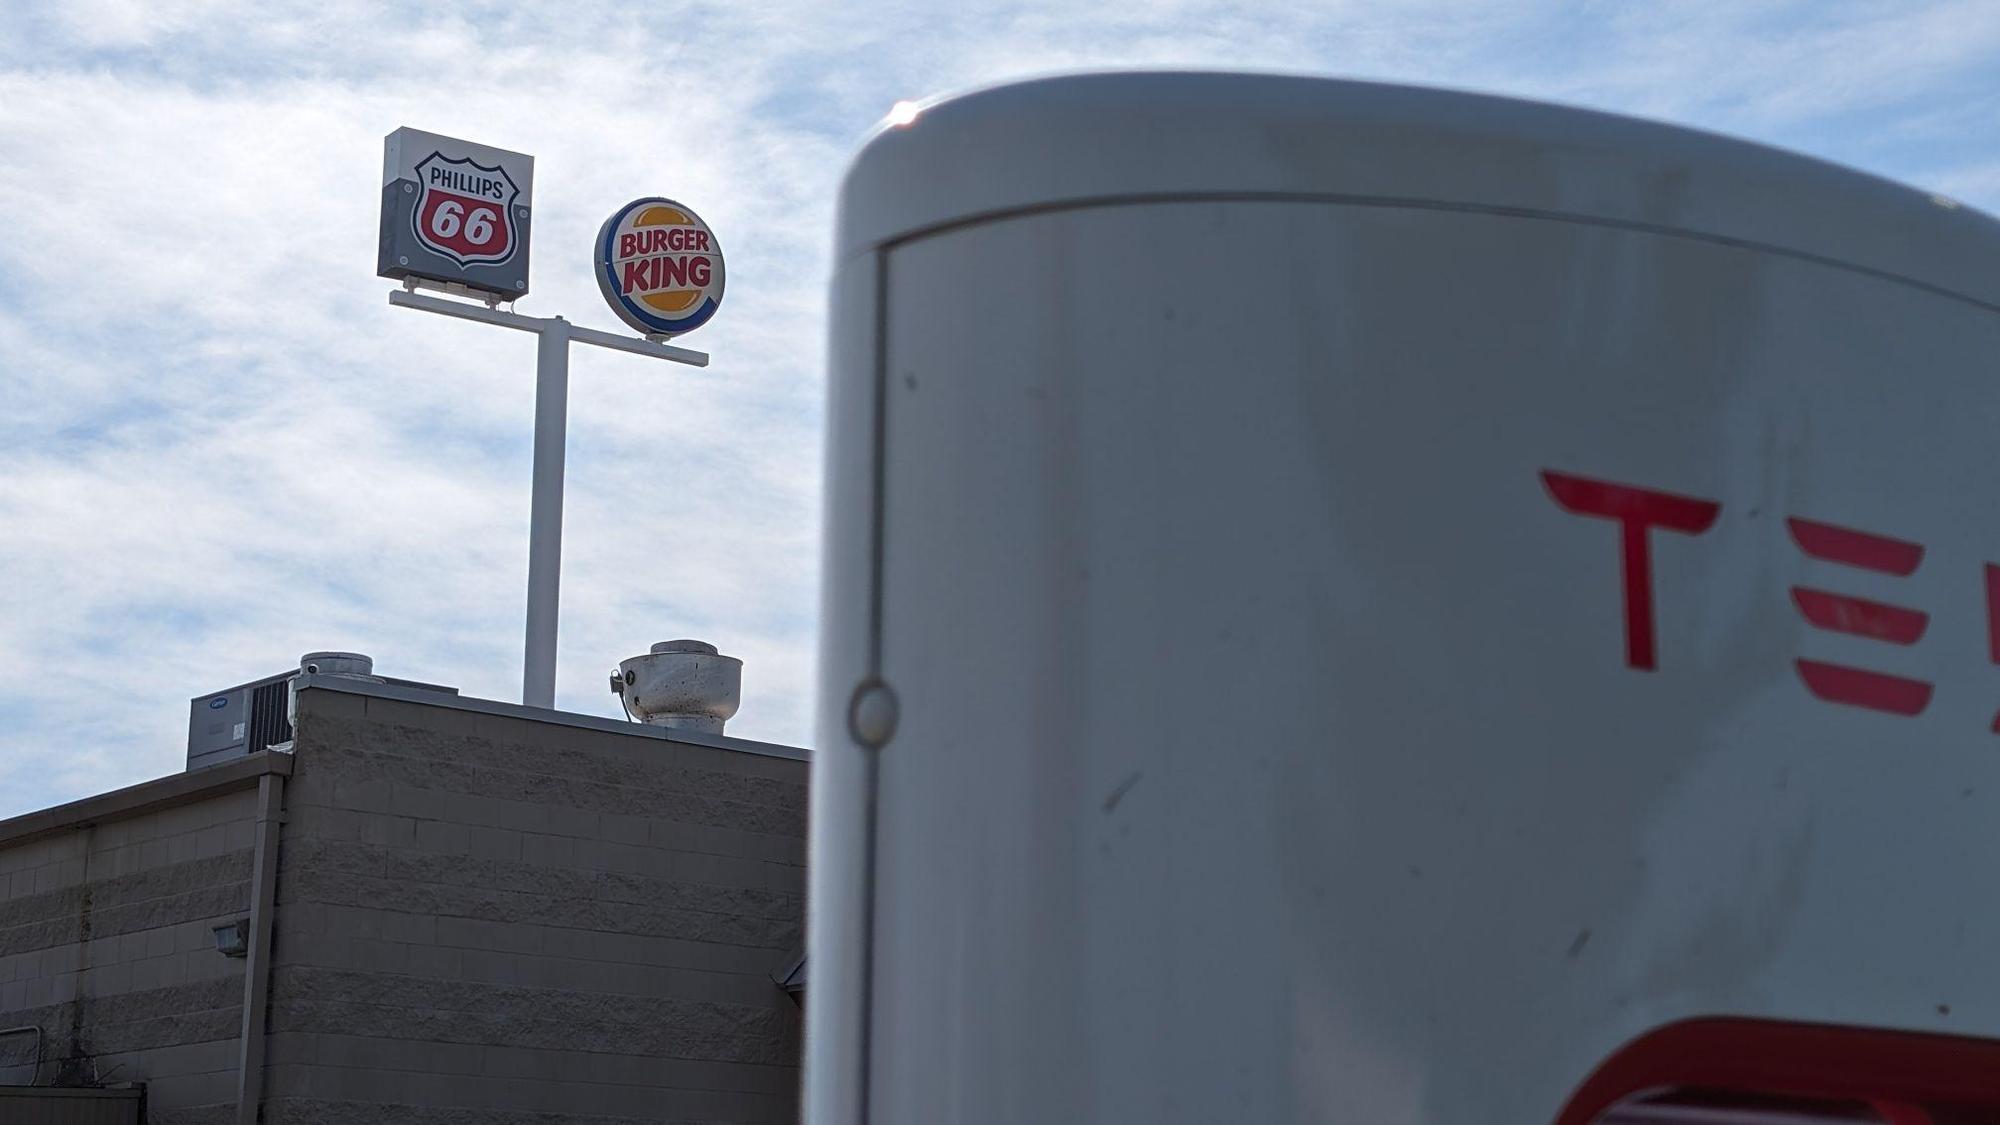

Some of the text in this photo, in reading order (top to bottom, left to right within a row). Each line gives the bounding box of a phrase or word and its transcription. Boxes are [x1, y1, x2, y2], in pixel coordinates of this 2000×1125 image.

[430, 166, 504, 200] PHILLIPS
[431, 200, 498, 245] 66
[619, 228, 710, 259] BURGER
[622, 256, 711, 295] KING
[1538, 467, 2000, 735] TE
